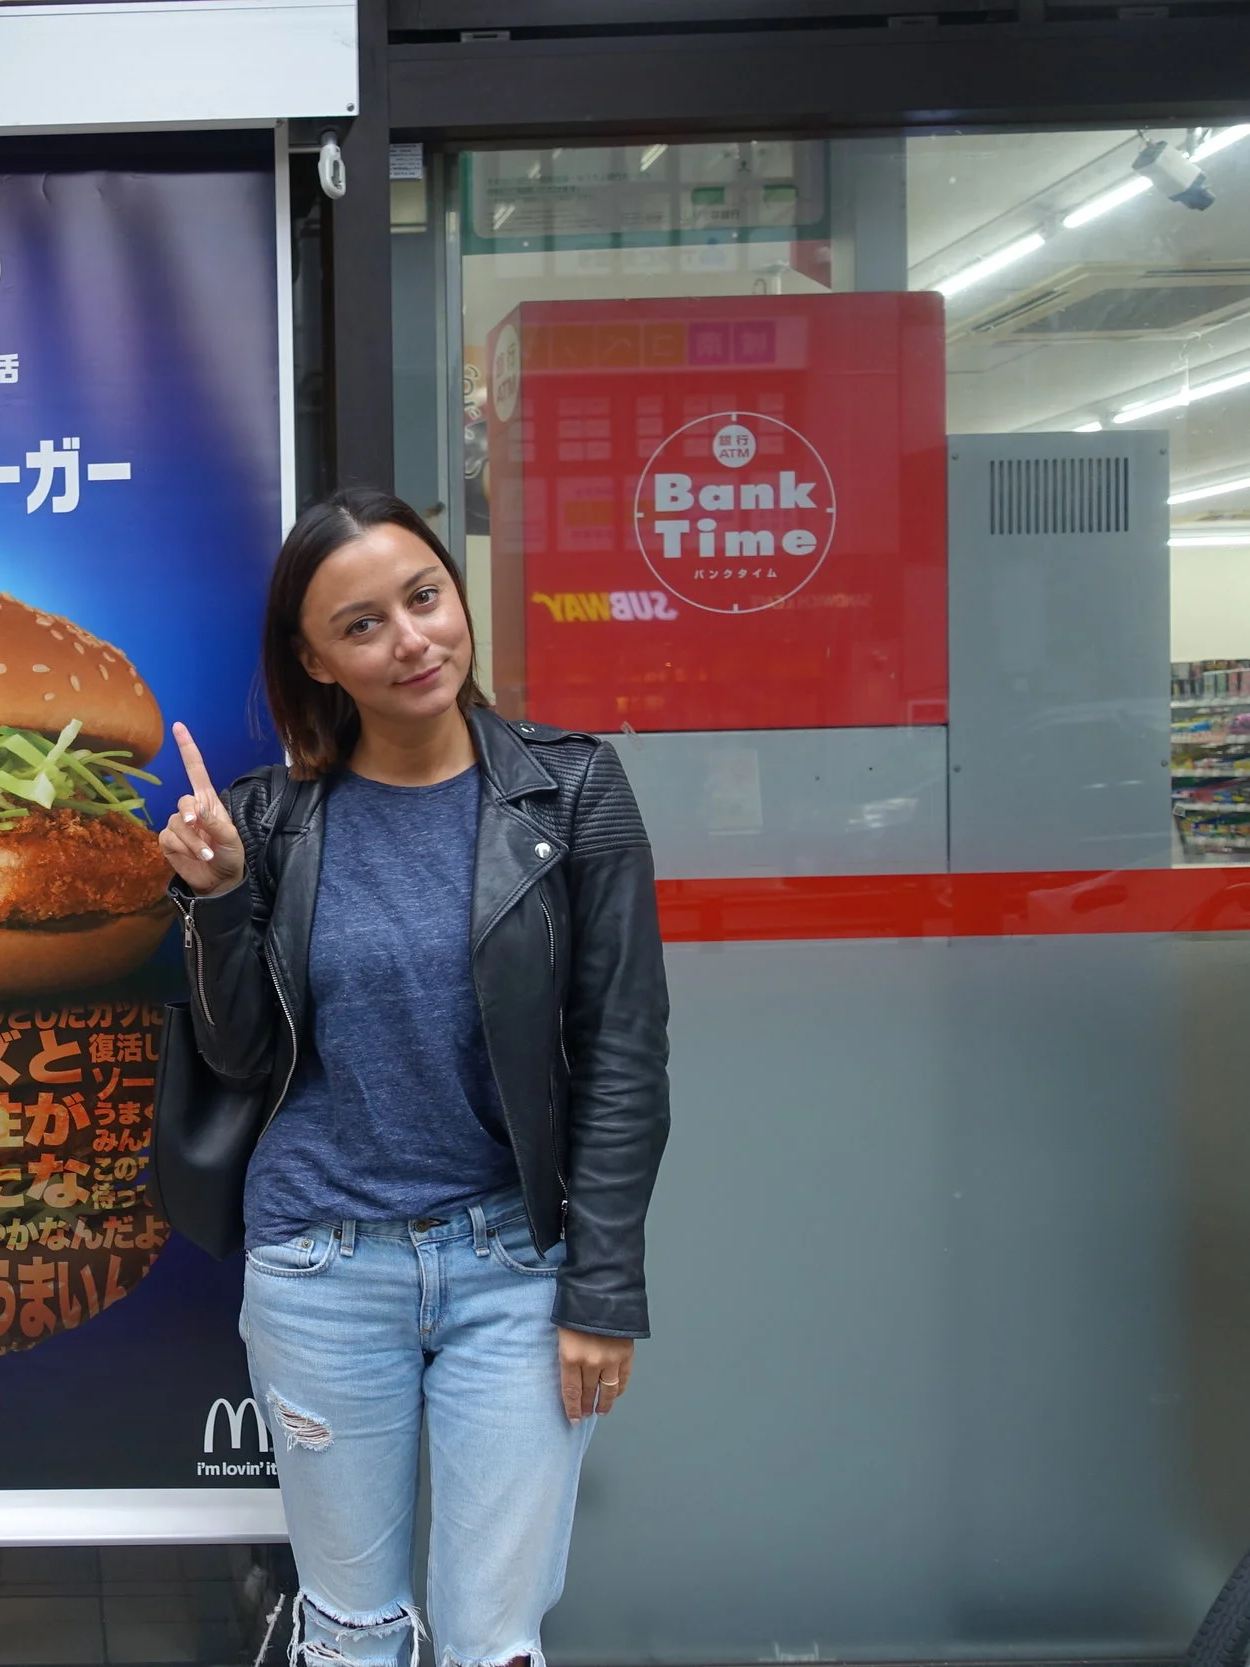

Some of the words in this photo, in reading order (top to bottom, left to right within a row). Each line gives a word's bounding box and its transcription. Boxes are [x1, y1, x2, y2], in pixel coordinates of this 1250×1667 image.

[719, 448, 750, 459] ATM
[654, 470, 818, 512] Bank
[654, 518, 818, 558] Time
[197, 1462, 220, 1476] i'm
[222, 1462, 264, 1476] lovin'
